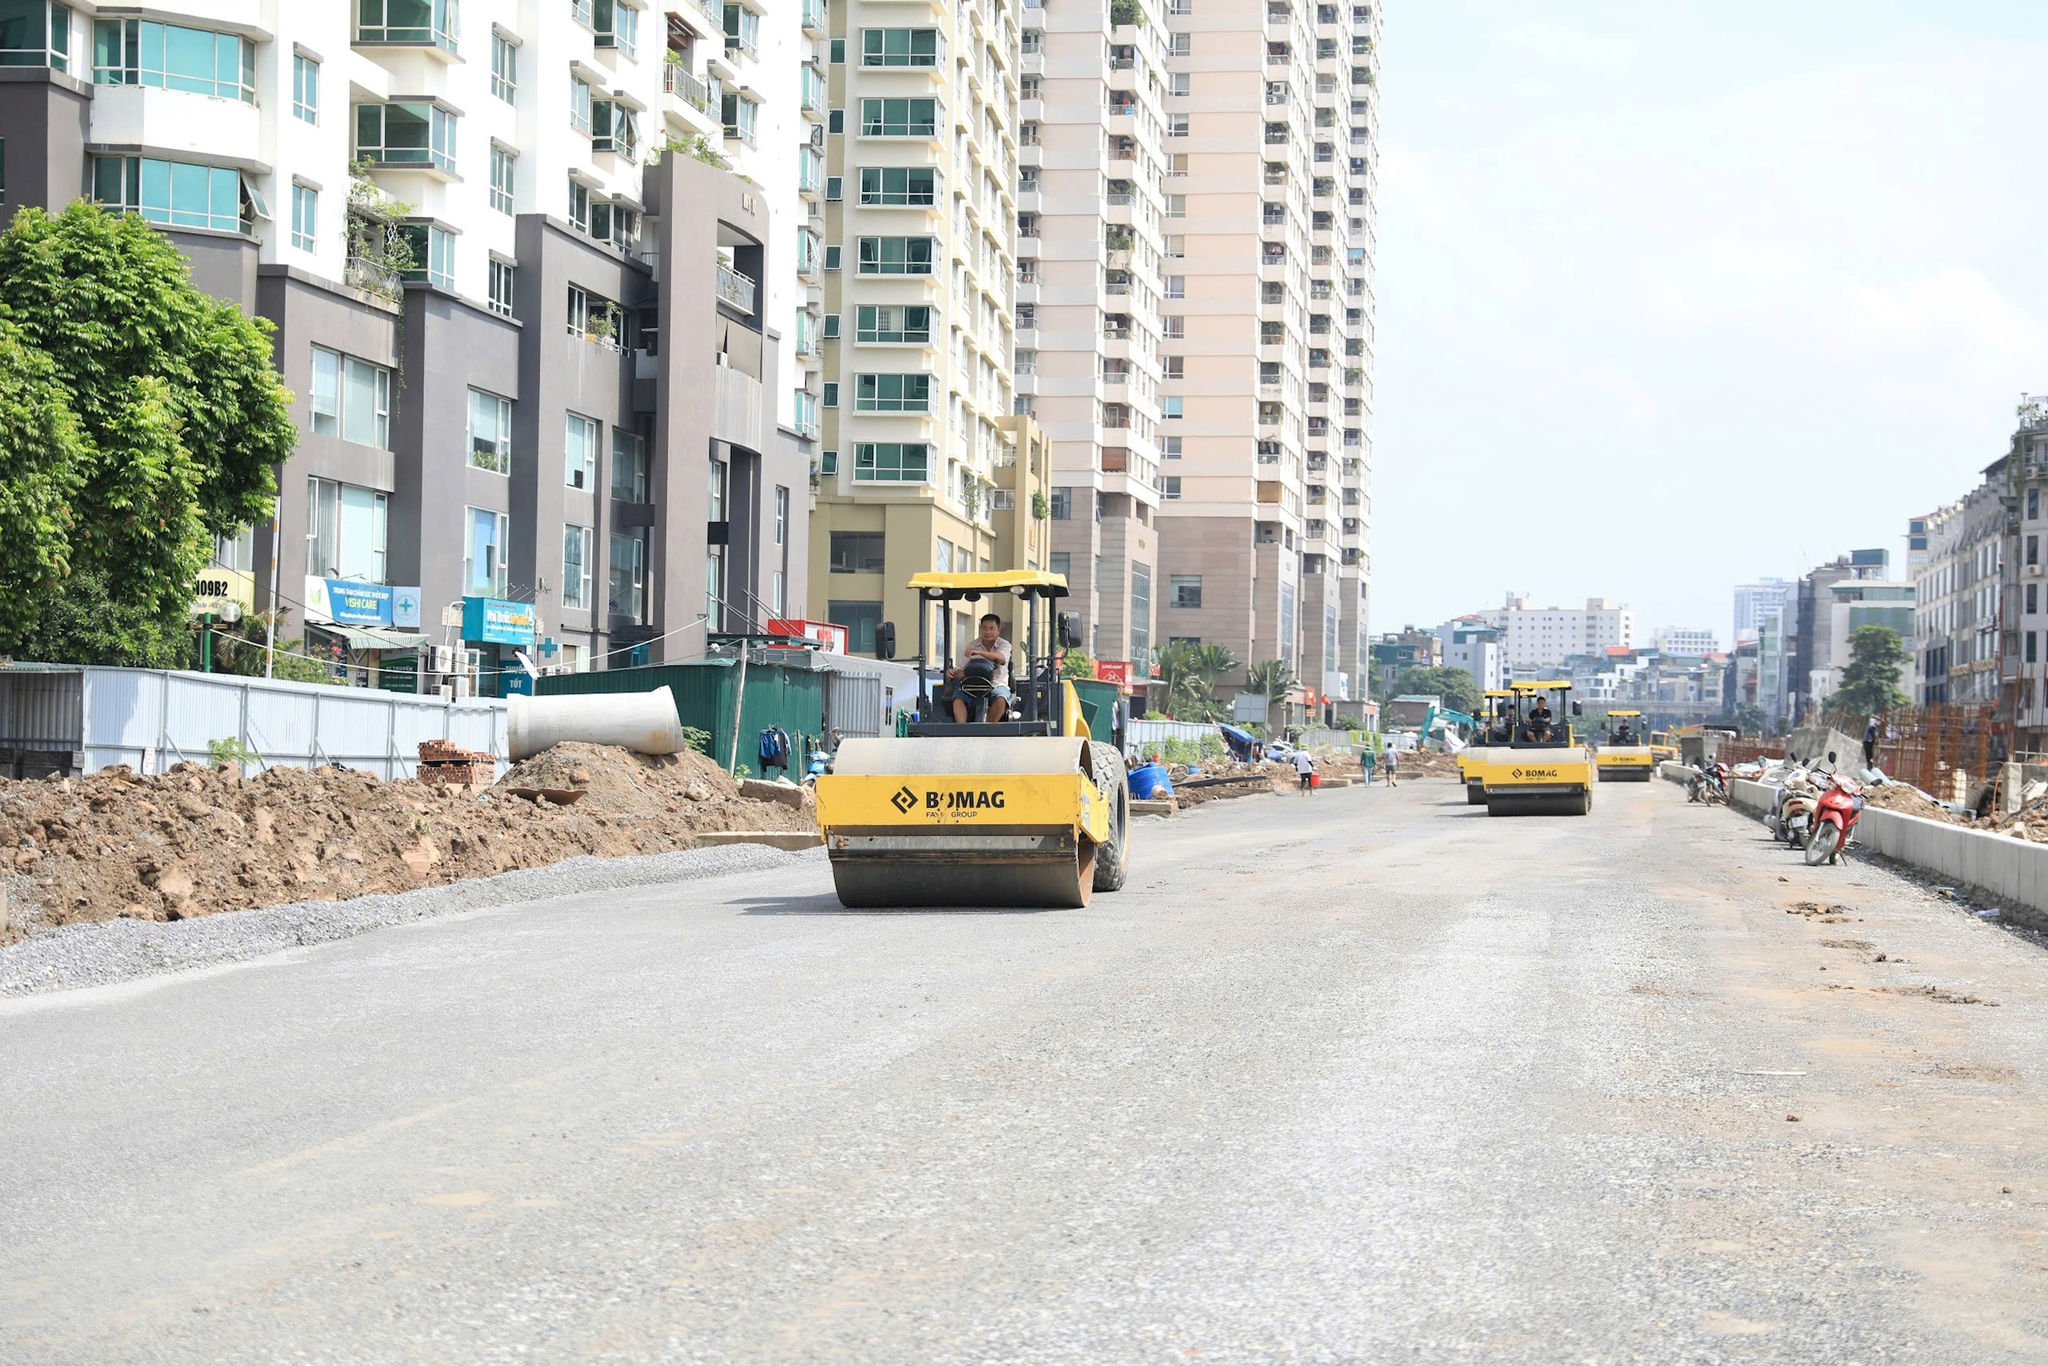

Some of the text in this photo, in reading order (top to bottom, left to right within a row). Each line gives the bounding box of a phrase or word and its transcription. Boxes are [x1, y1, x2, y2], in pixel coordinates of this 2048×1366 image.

[361, 598, 377, 610] CARE
[509, 677, 523, 688] TỐT
[1525, 769, 1558, 777] BOMAG
